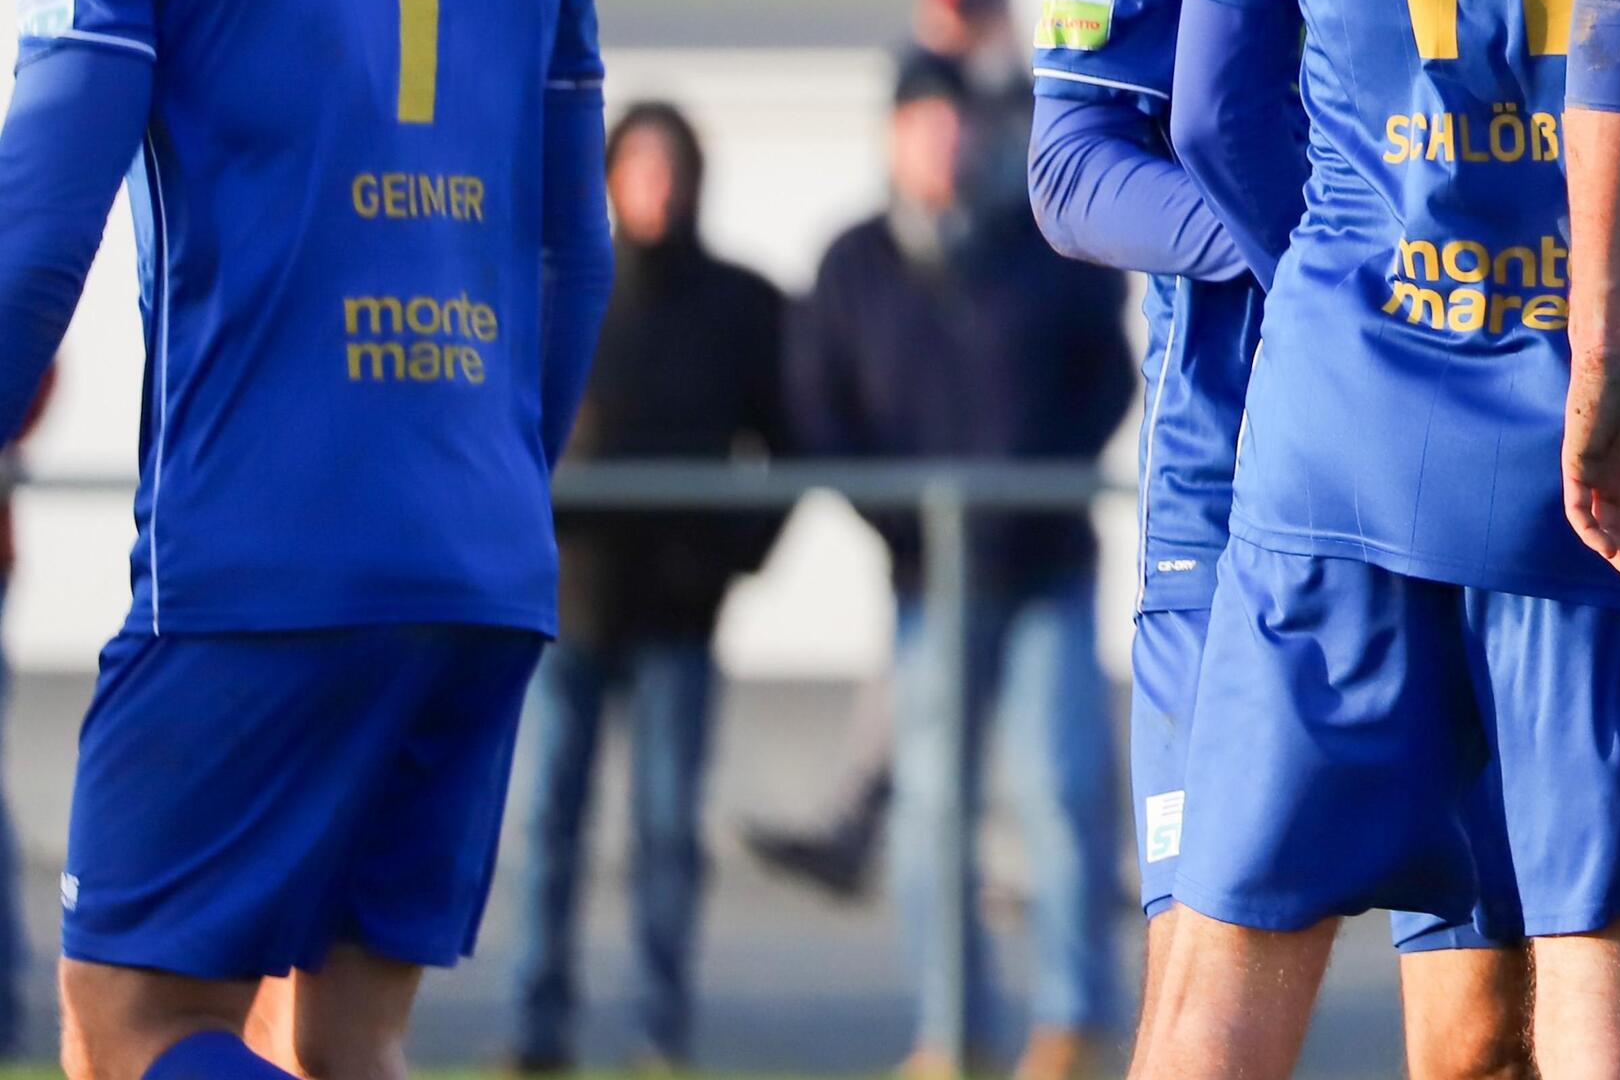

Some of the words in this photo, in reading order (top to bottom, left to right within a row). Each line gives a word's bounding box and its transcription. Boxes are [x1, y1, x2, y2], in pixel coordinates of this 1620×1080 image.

[352, 173, 484, 222] GEIMER
[1393, 235, 1571, 288] mont
[344, 290, 498, 342] monte
[1382, 280, 1569, 333] mare
[347, 341, 486, 385] mare
